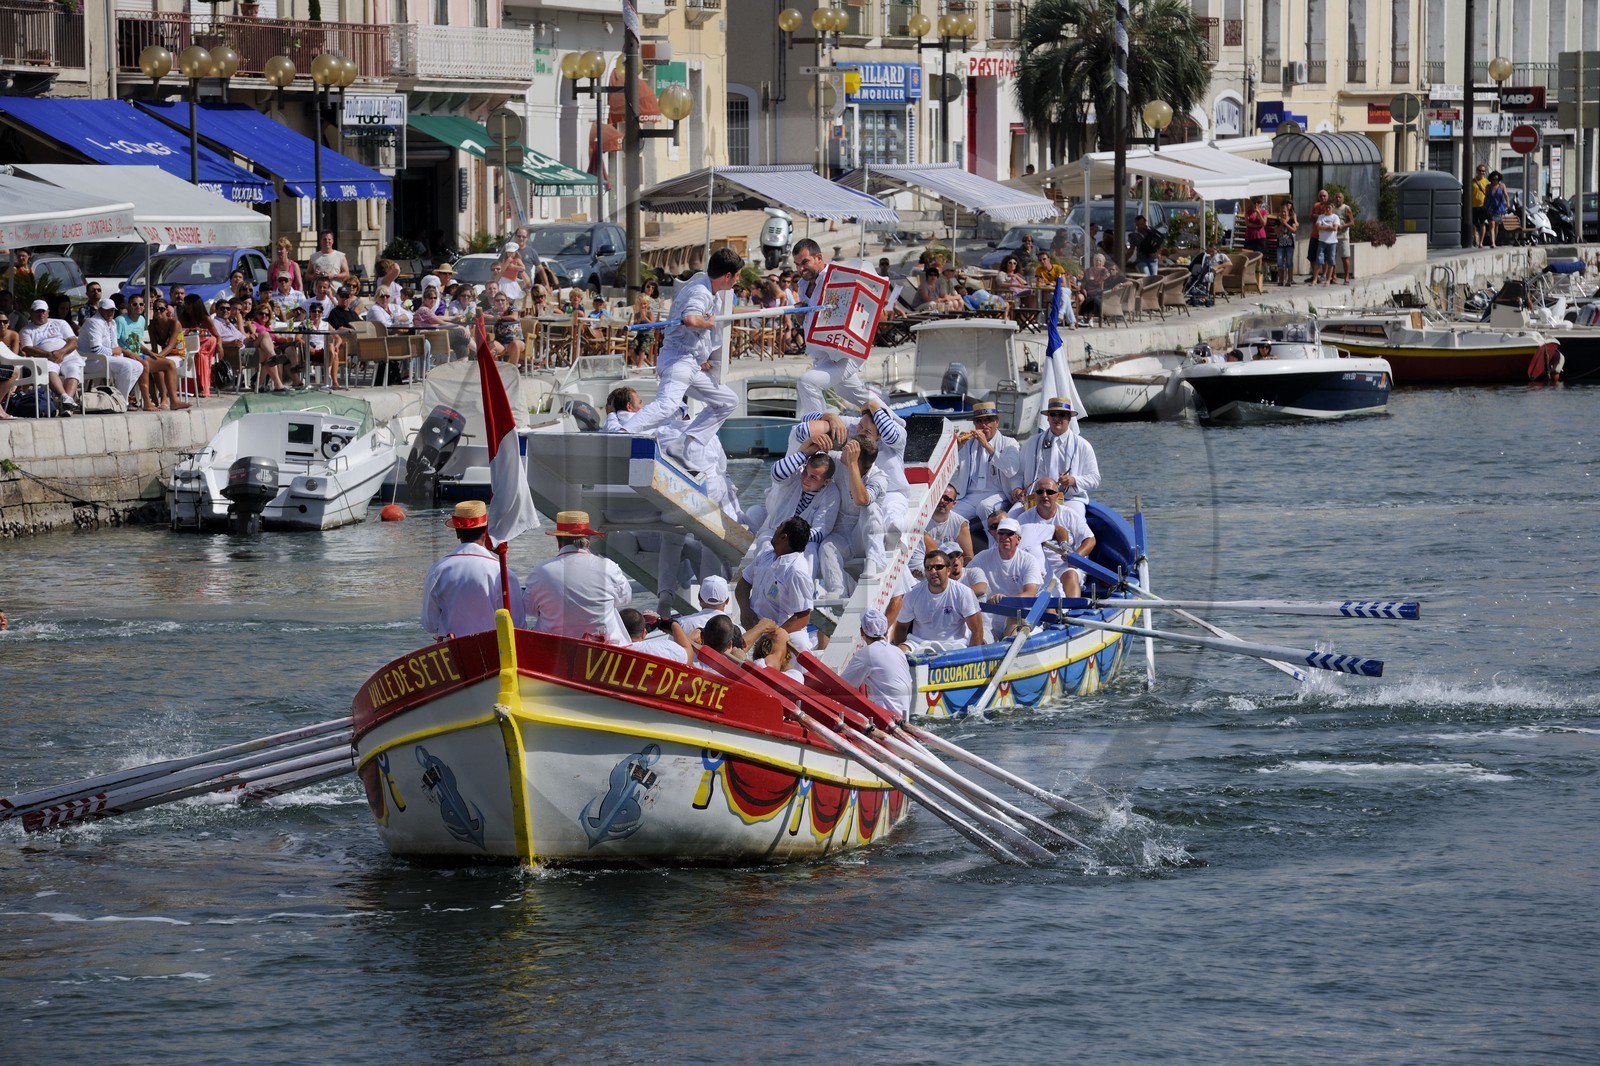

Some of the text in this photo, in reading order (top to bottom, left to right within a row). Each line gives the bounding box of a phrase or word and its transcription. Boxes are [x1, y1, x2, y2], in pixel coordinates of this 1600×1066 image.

[859, 65, 905, 86] AILLARD
[340, 185, 358, 197] TAPAS
[368, 647, 460, 708] VILLE DE SETE
[585, 648, 729, 710] VILLE DE SETE
[943, 661, 986, 683] QUARTIER
